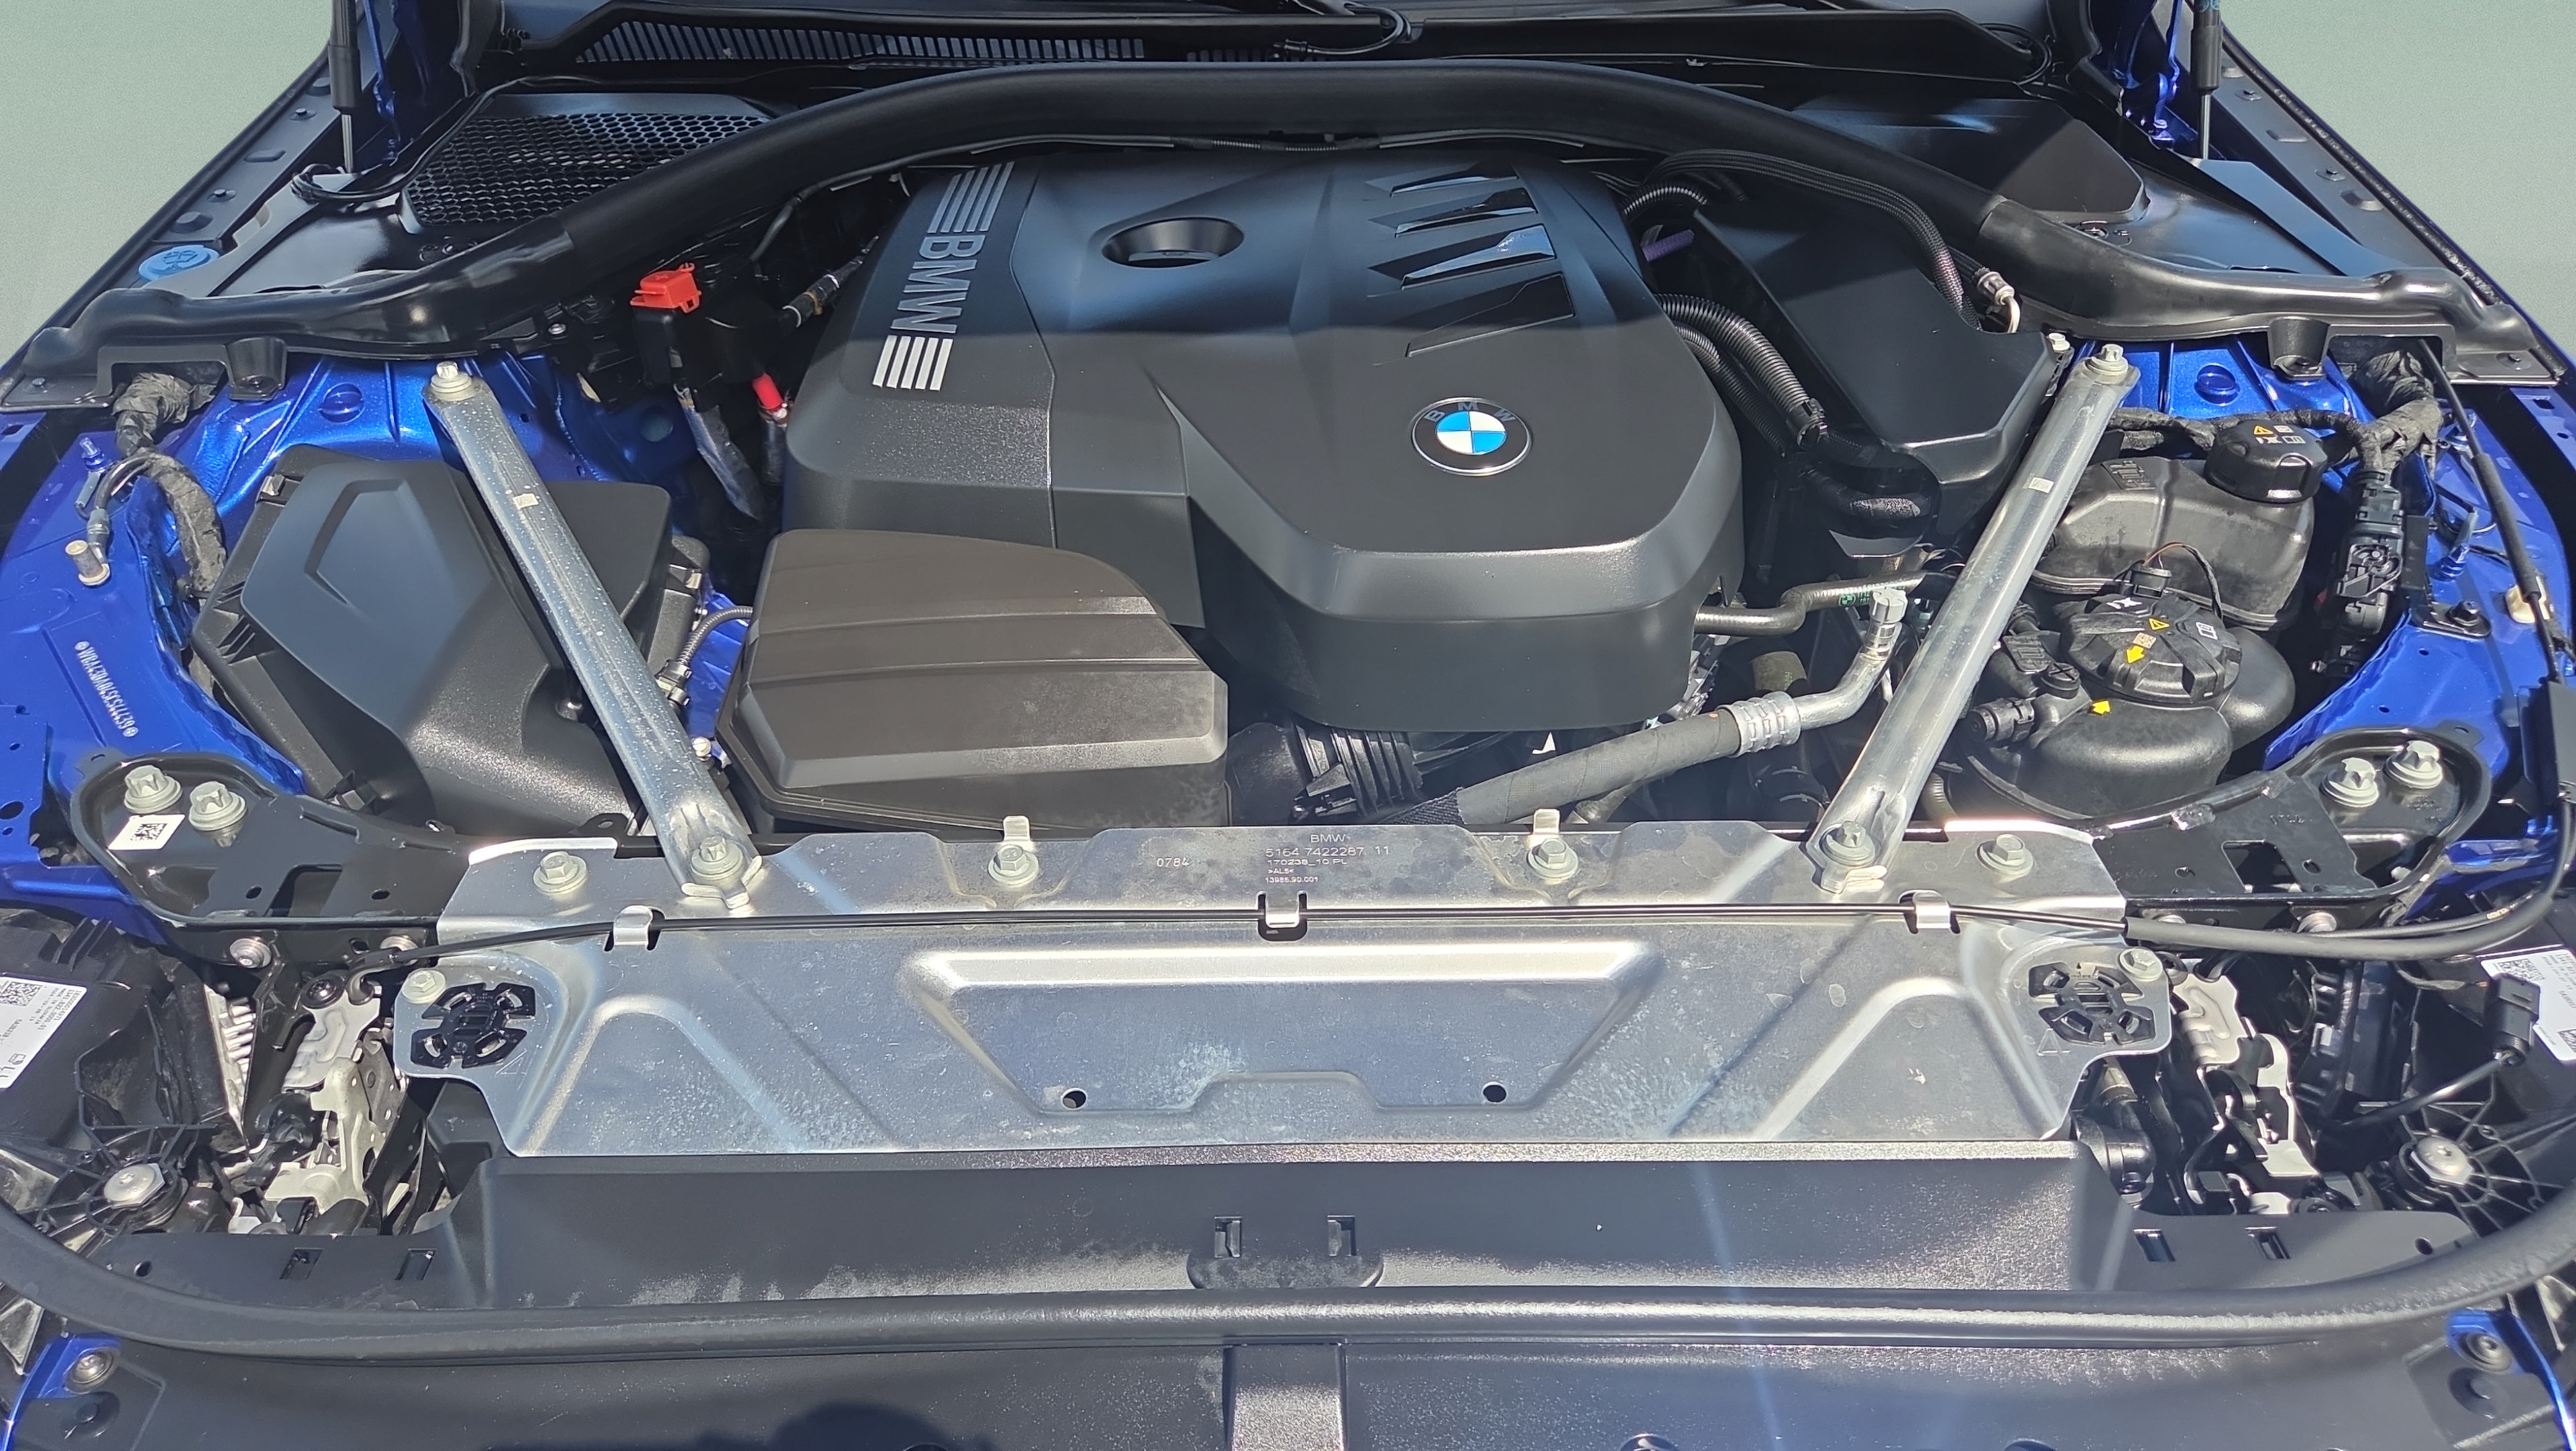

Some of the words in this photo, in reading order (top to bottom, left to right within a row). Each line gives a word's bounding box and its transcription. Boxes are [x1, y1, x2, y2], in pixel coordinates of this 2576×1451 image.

[890, 234, 986, 334] BMW
[1424, 402, 1516, 423] BMW
[1310, 834, 1346, 844] BMW
[1265, 848, 1300, 857] 5164
[1304, 846, 1365, 856] 7422287
[1375, 846, 1390, 855] 11
[1156, 856, 1189, 867] 0784
